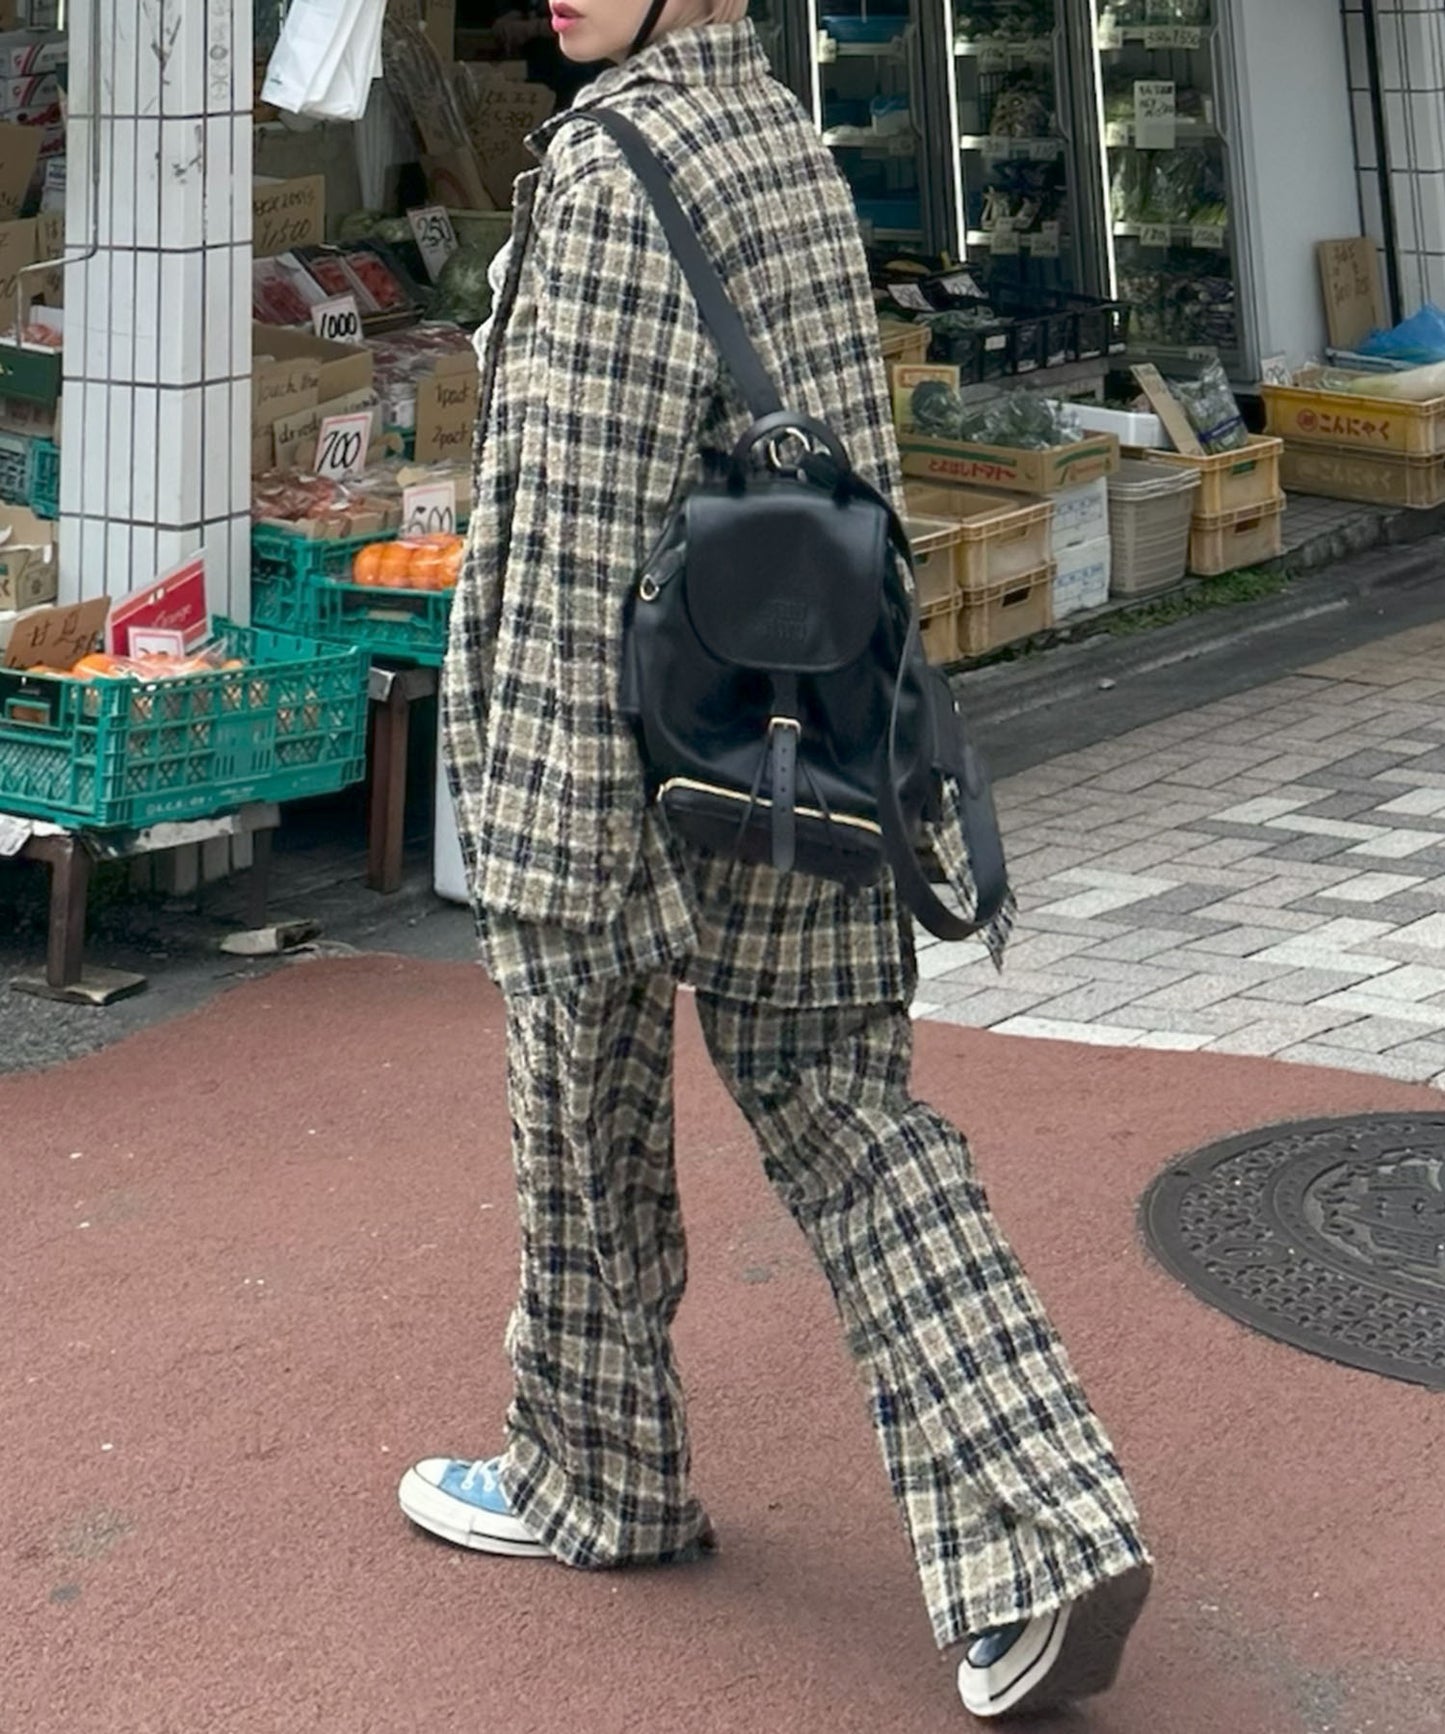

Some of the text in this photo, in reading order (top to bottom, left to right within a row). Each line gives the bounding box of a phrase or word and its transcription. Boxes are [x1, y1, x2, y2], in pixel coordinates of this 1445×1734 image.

[320, 312, 357, 338] 1000
[1319, 412, 1391, 441] こんにゃく
[317, 429, 361, 473] 700
